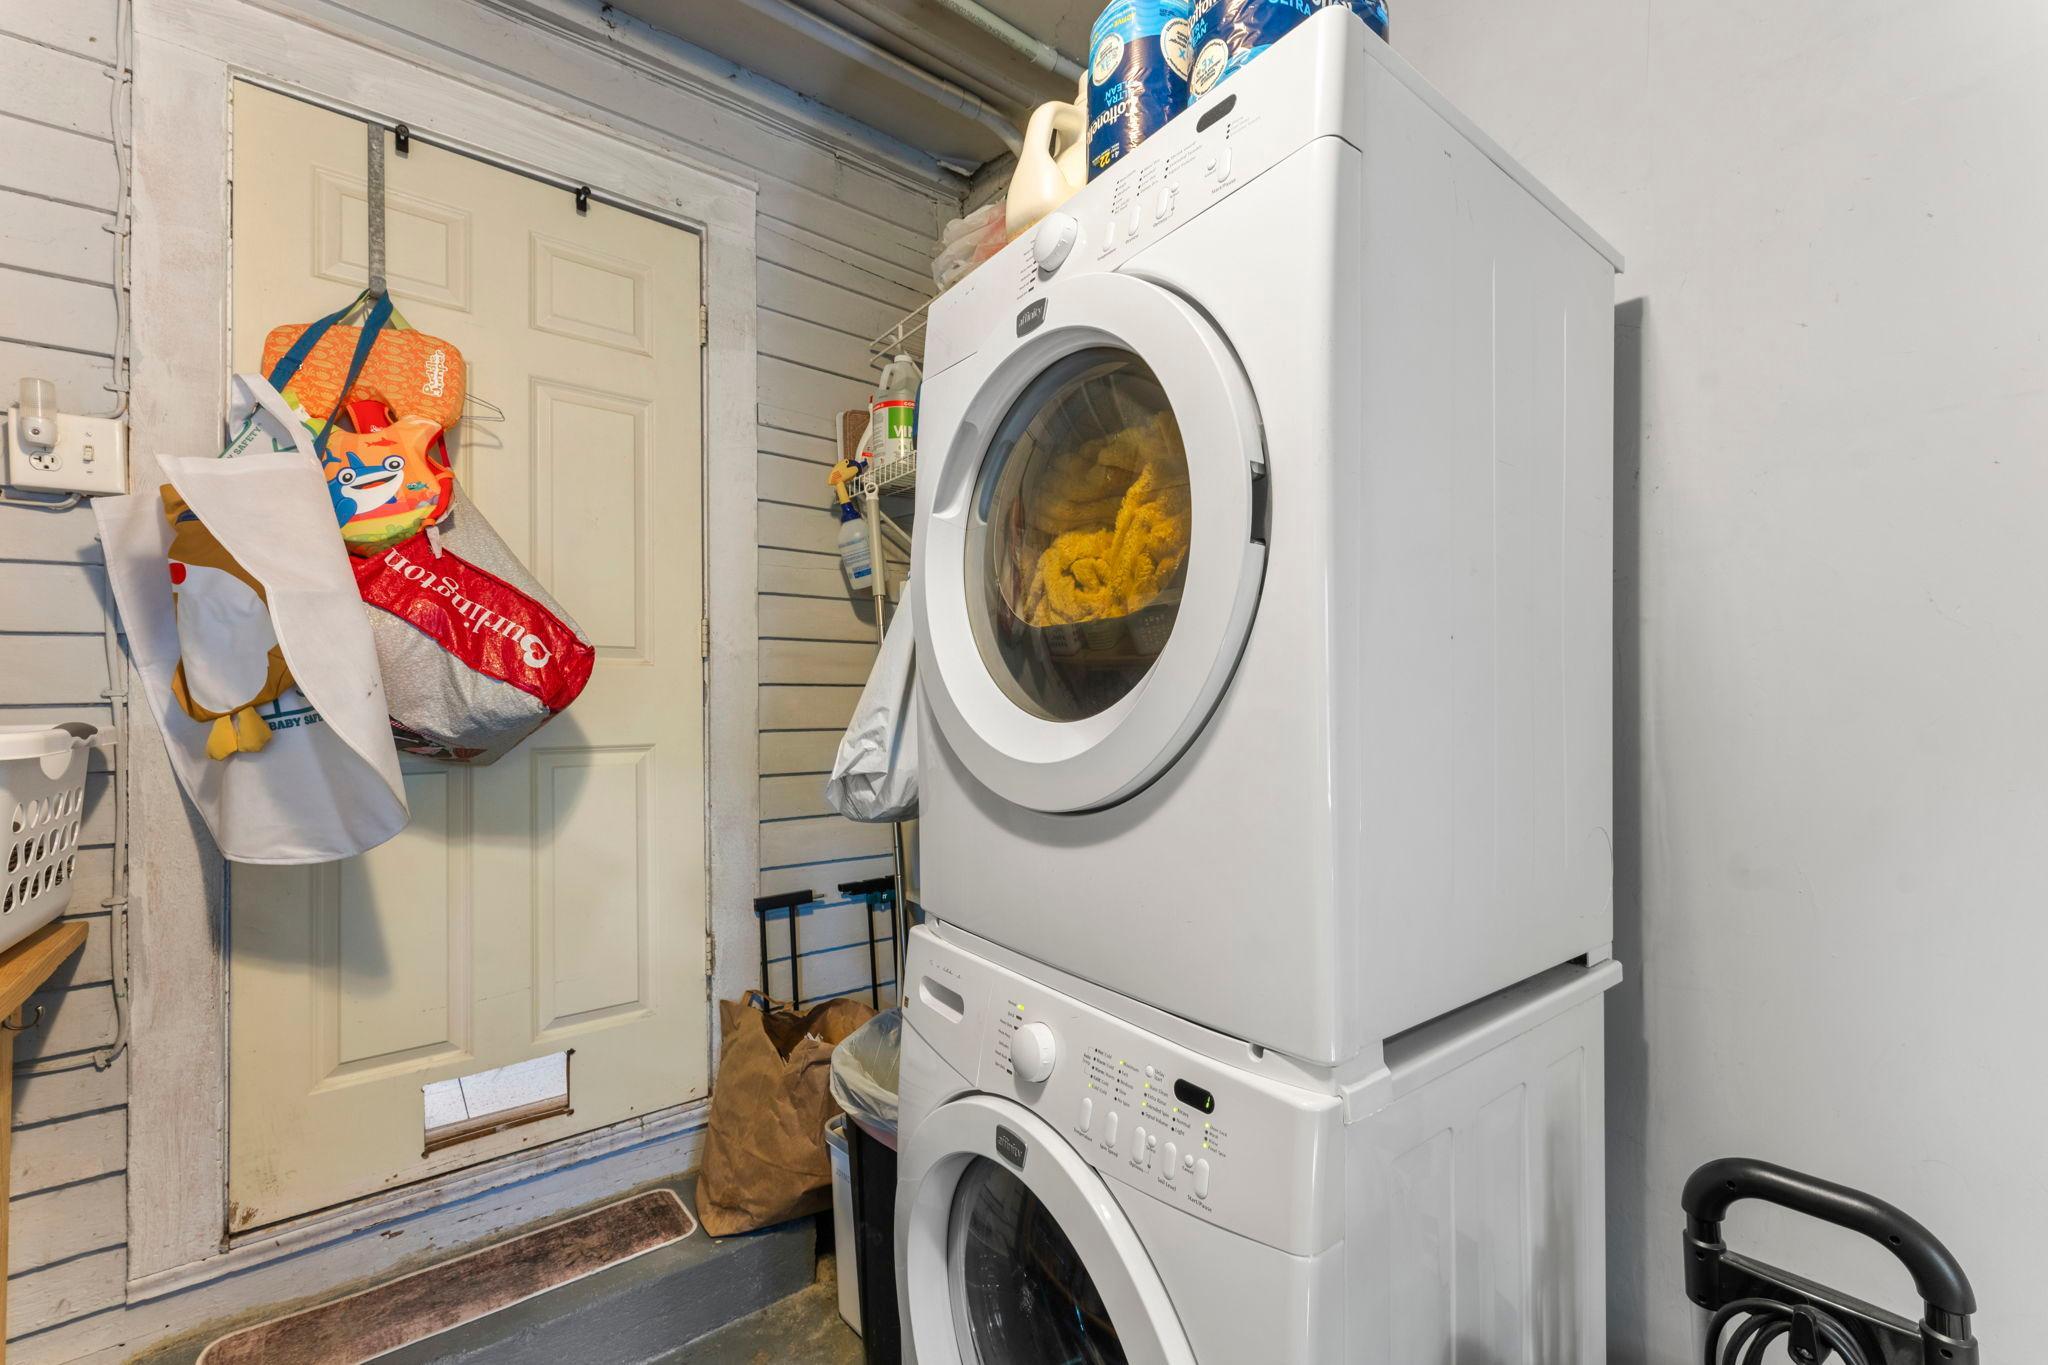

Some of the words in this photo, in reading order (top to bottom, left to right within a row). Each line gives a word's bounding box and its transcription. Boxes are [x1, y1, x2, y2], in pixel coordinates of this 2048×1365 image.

[431, 349, 448, 397] Jumper
[233, 424, 261, 456] SAFETY
[384, 547, 552, 669] Burlington
[268, 717, 301, 731] BABY
